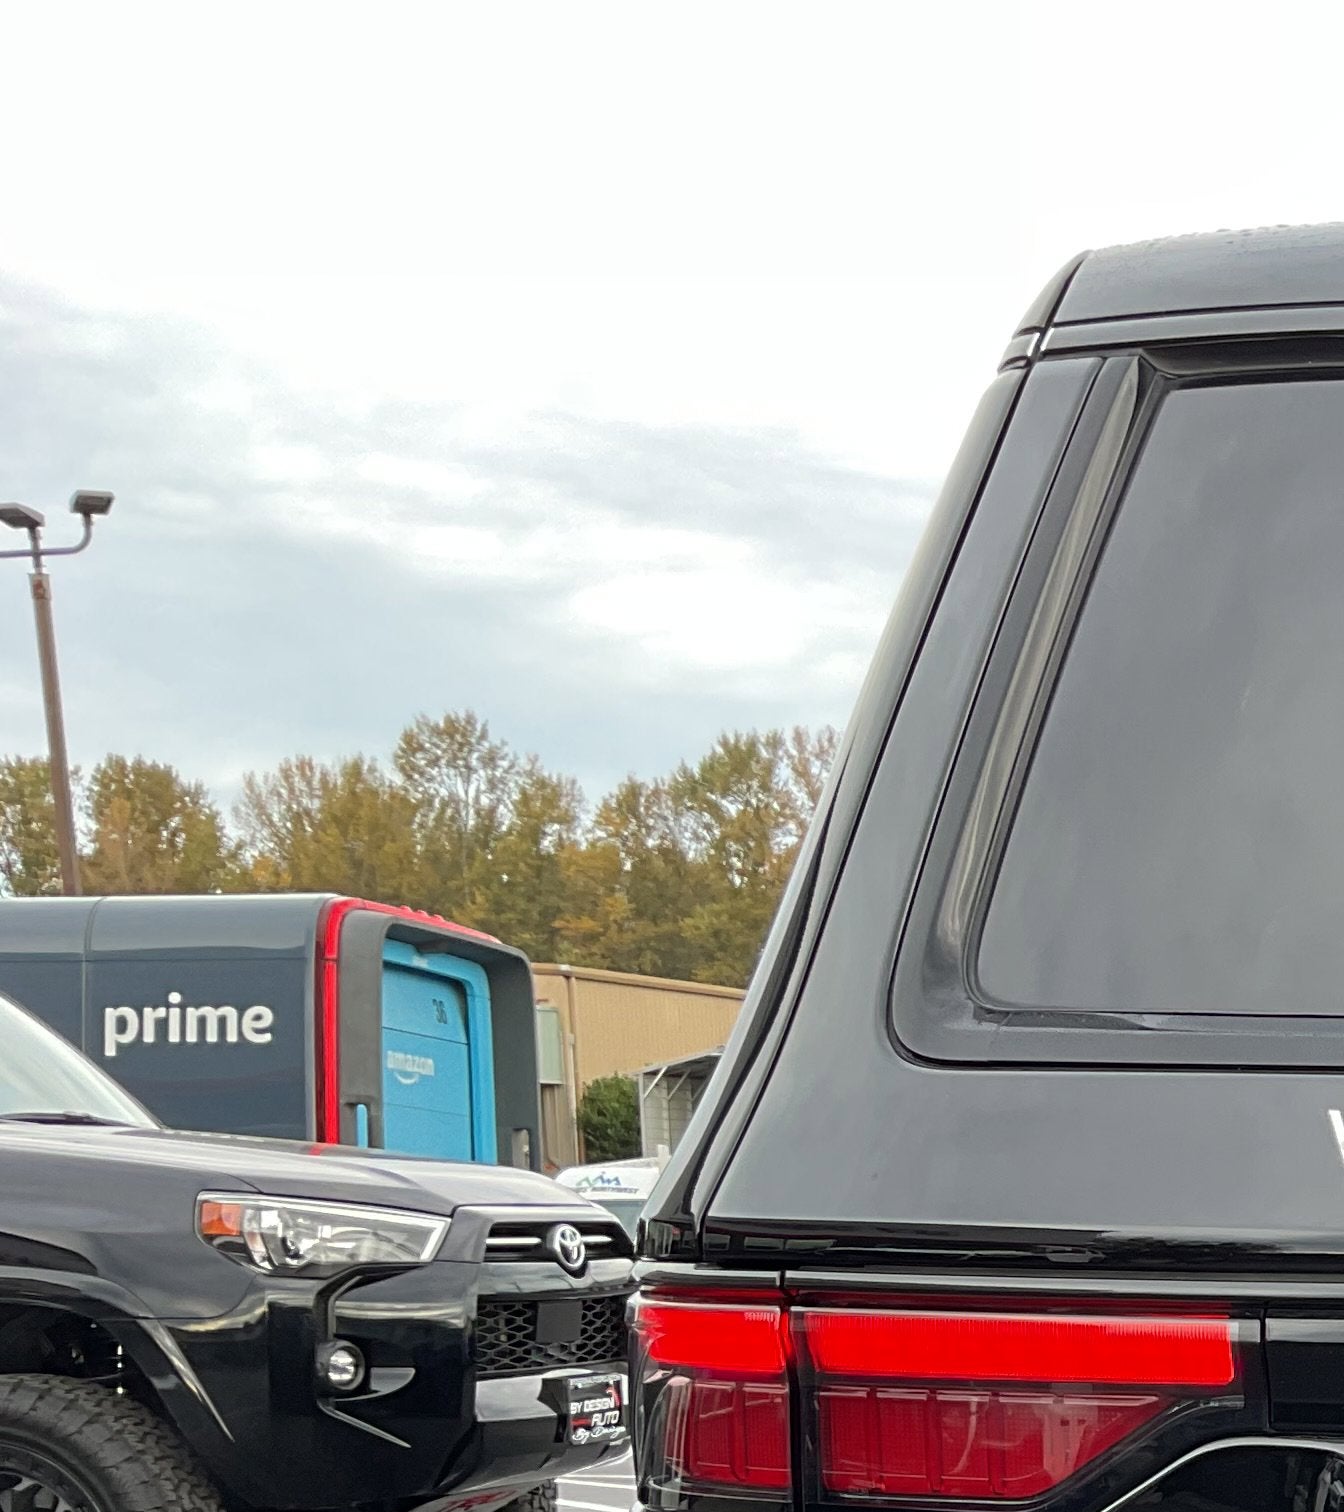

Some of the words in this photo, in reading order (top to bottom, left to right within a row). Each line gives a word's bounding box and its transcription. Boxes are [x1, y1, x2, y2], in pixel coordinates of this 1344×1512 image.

[104, 991, 274, 1057] prime
[387, 1050, 434, 1076] amazon
[570, 1401, 582, 1415] BY
[591, 1410, 620, 1427] AUTO
